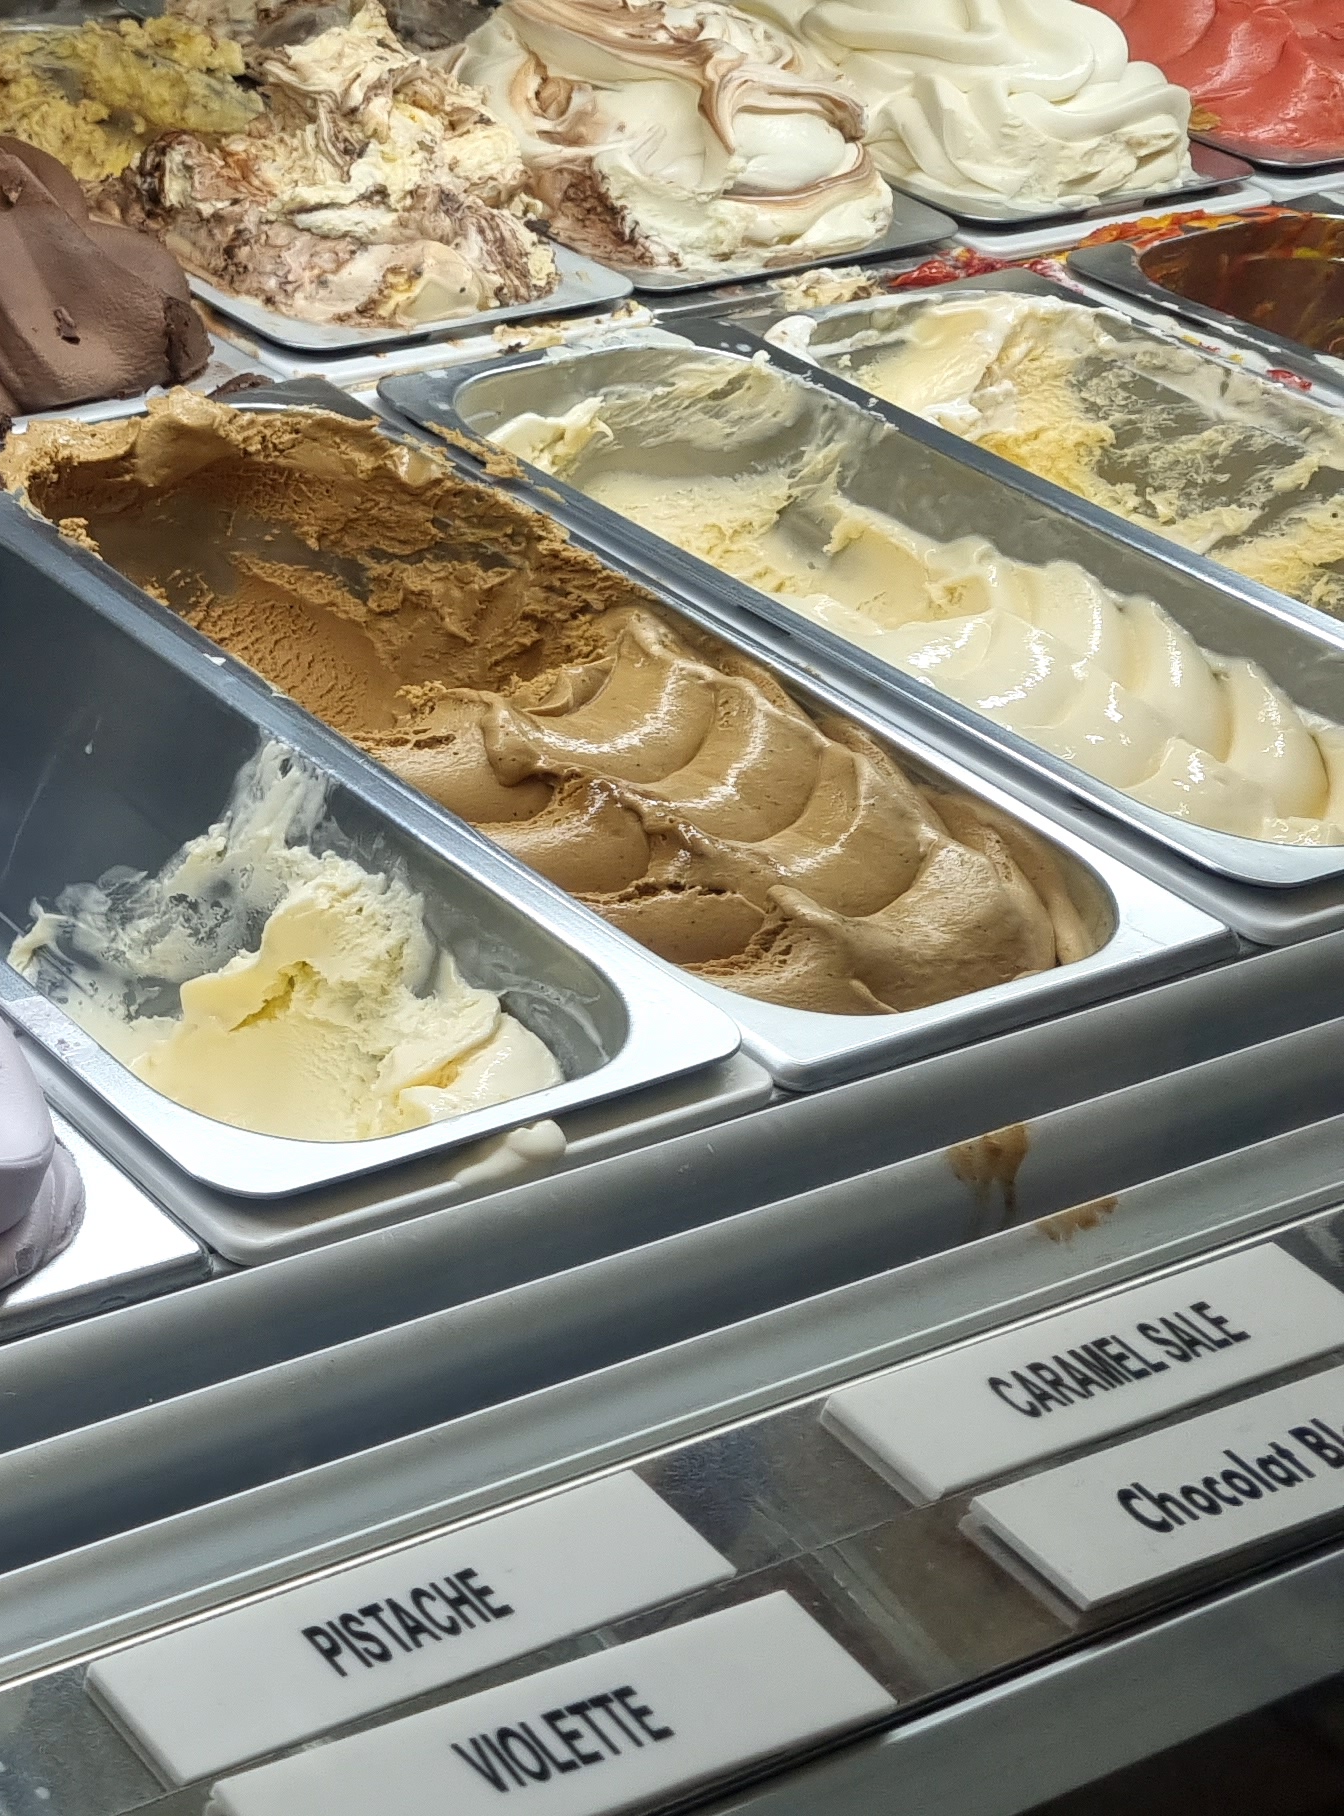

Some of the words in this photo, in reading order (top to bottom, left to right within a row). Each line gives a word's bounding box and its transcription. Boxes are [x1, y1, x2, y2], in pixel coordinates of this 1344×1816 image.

[987, 1334, 1171, 1418] CARAMEL
[1136, 1301, 1252, 1363] SALE
[1116, 1441, 1317, 1534] Chocolat
[1287, 1417, 1344, 1470] Bl
[301, 1567, 515, 1678] PISTACHE
[450, 1685, 675, 1793] VIOLETTE
